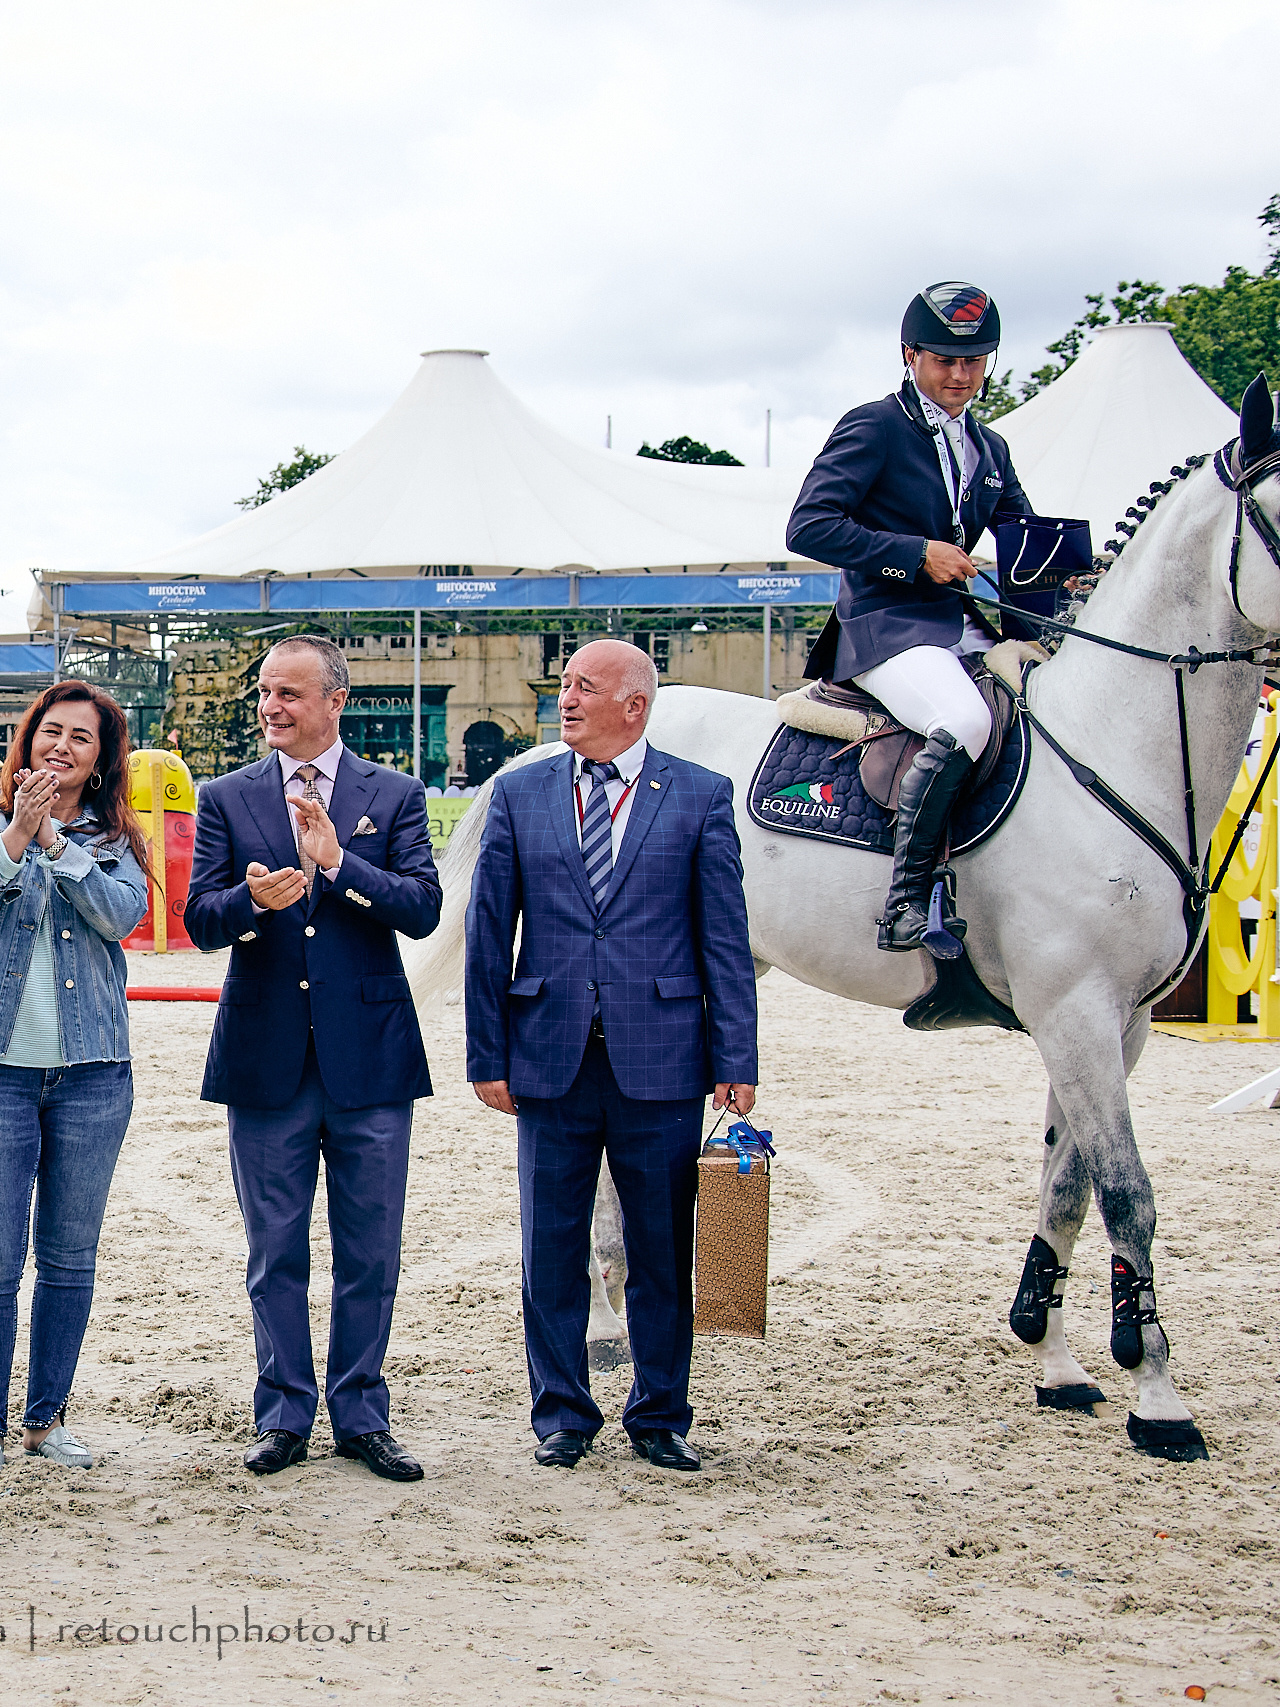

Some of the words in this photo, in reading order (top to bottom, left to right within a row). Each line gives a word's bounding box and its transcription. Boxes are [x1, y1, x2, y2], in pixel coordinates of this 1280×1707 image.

[436, 582, 496, 592] ИНГОССТРАХ
[738, 577, 801, 588] ИНГОССТРАХ
[148, 586, 206, 596] ИНГОССТРАХ
[760, 798, 840, 819] EQUILINE
